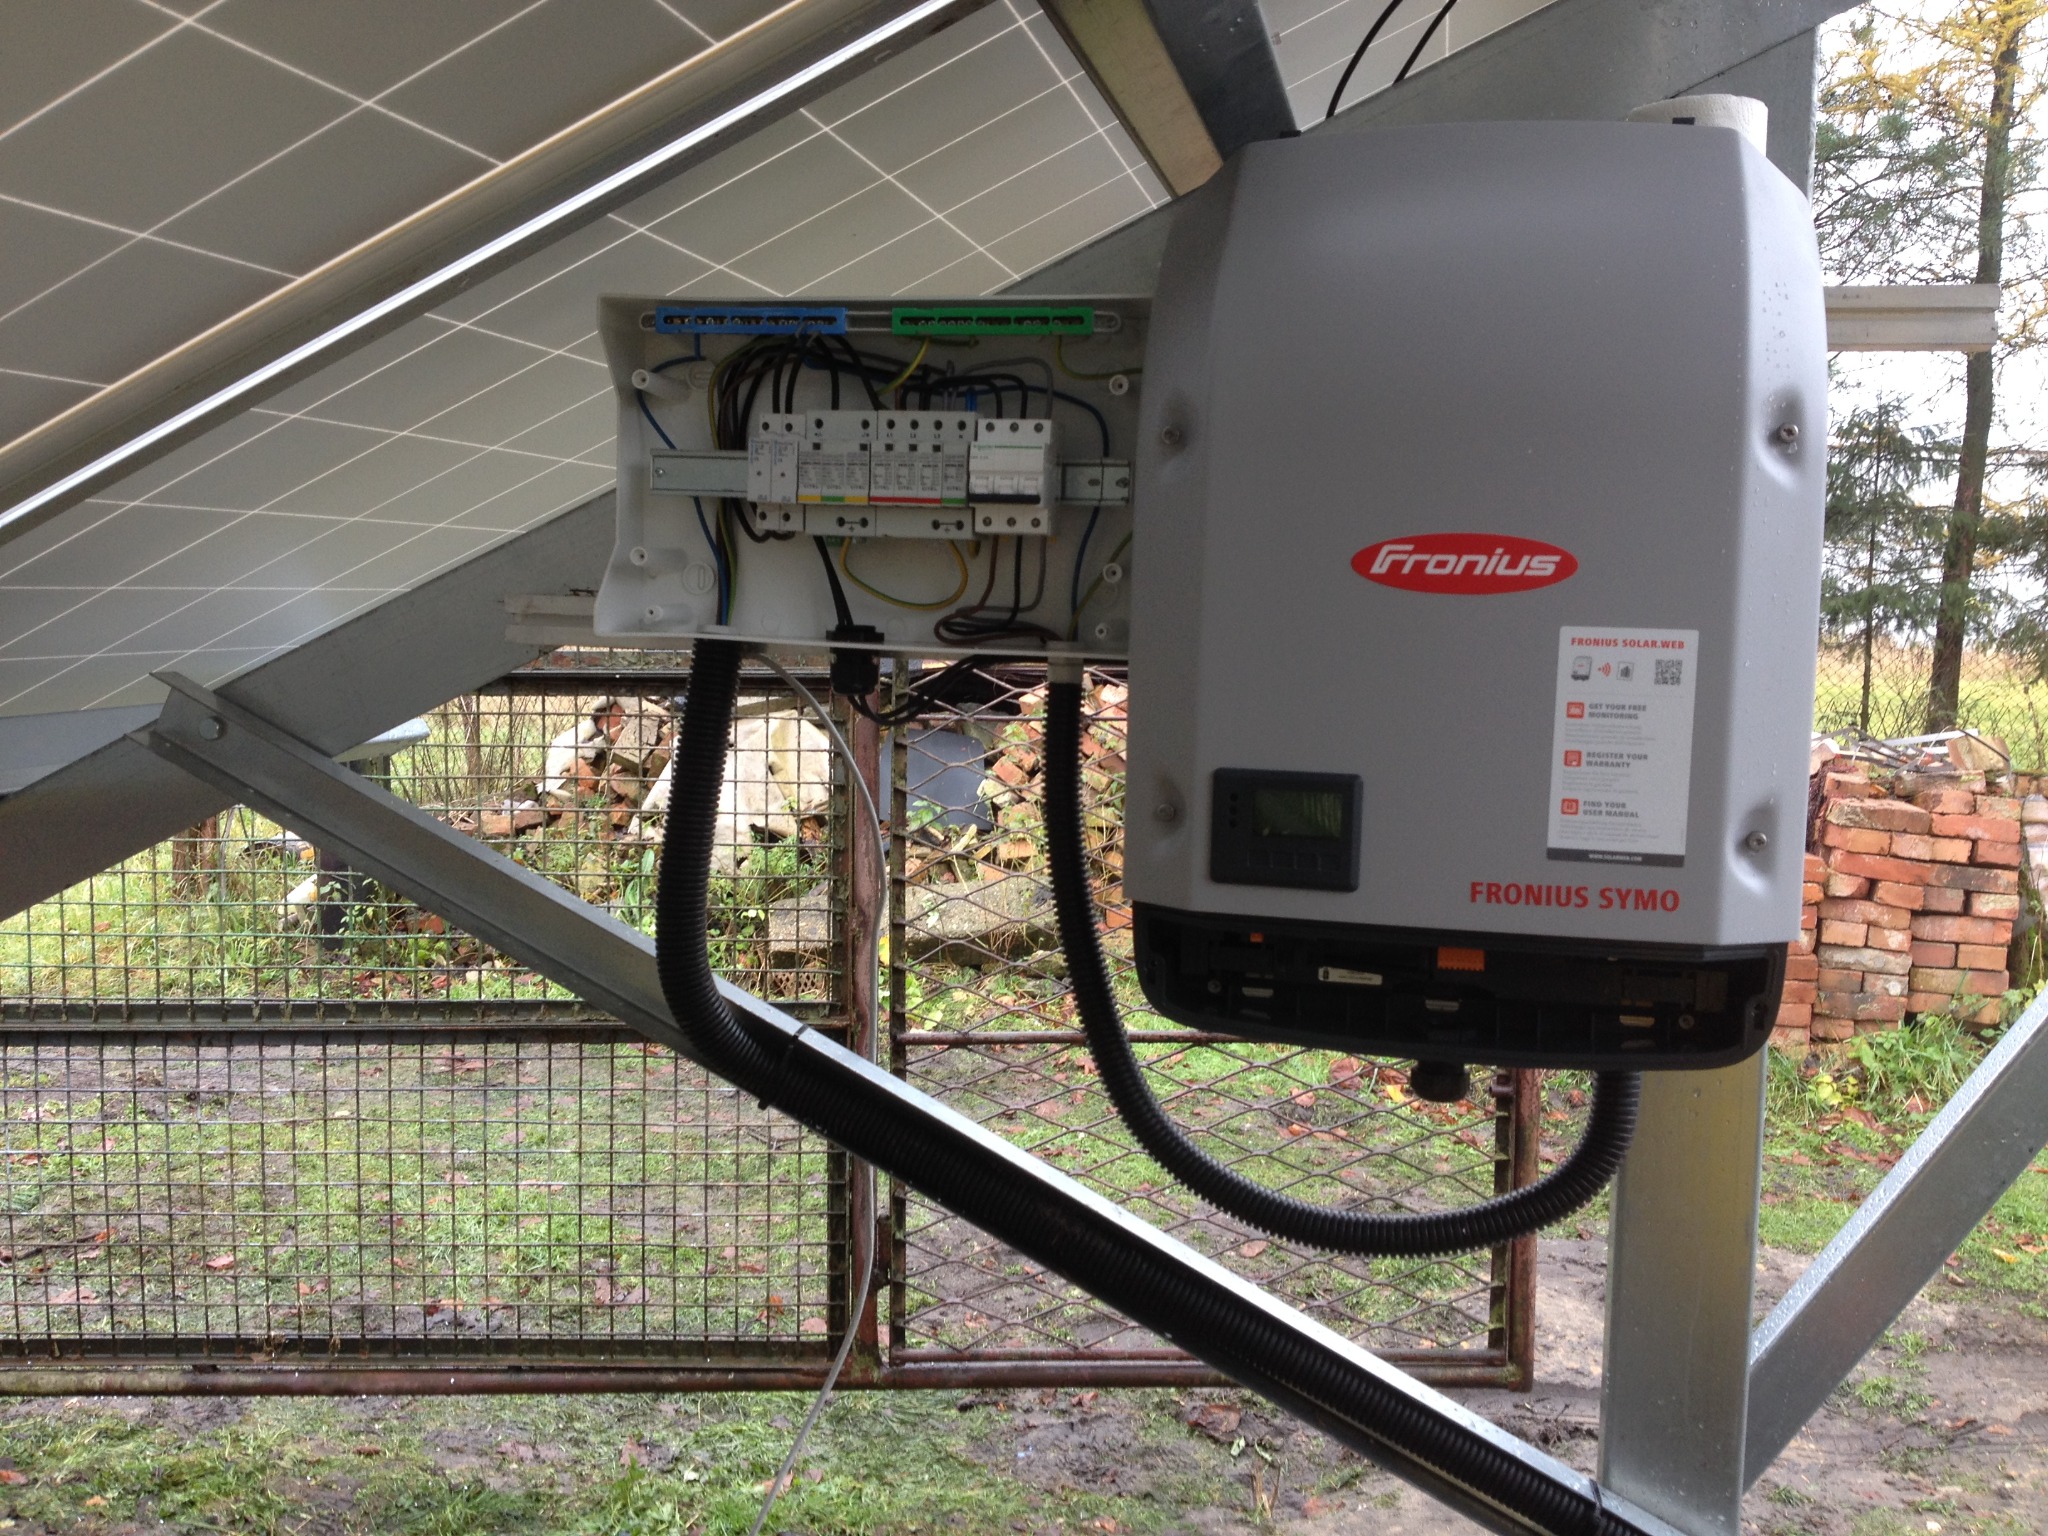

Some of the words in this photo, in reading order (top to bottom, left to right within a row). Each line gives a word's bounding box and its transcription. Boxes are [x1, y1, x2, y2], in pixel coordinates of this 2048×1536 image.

[1369, 544, 1562, 576] Fronius
[1570, 637, 1619, 648] FRONIUS
[1622, 639, 1685, 650] SOLAR.WEB
[1605, 703, 1626, 711] YOUR
[1628, 704, 1647, 712] FREE
[1588, 711, 1639, 720] MONITORING
[1586, 760, 1631, 768] WARRANTY
[1583, 800, 1602, 808] FIND
[1604, 801, 1626, 809] YOUR
[1605, 810, 1639, 818] MANUAL
[1470, 881, 1589, 908] FRONIUS
[1598, 887, 1680, 912] SYMO
